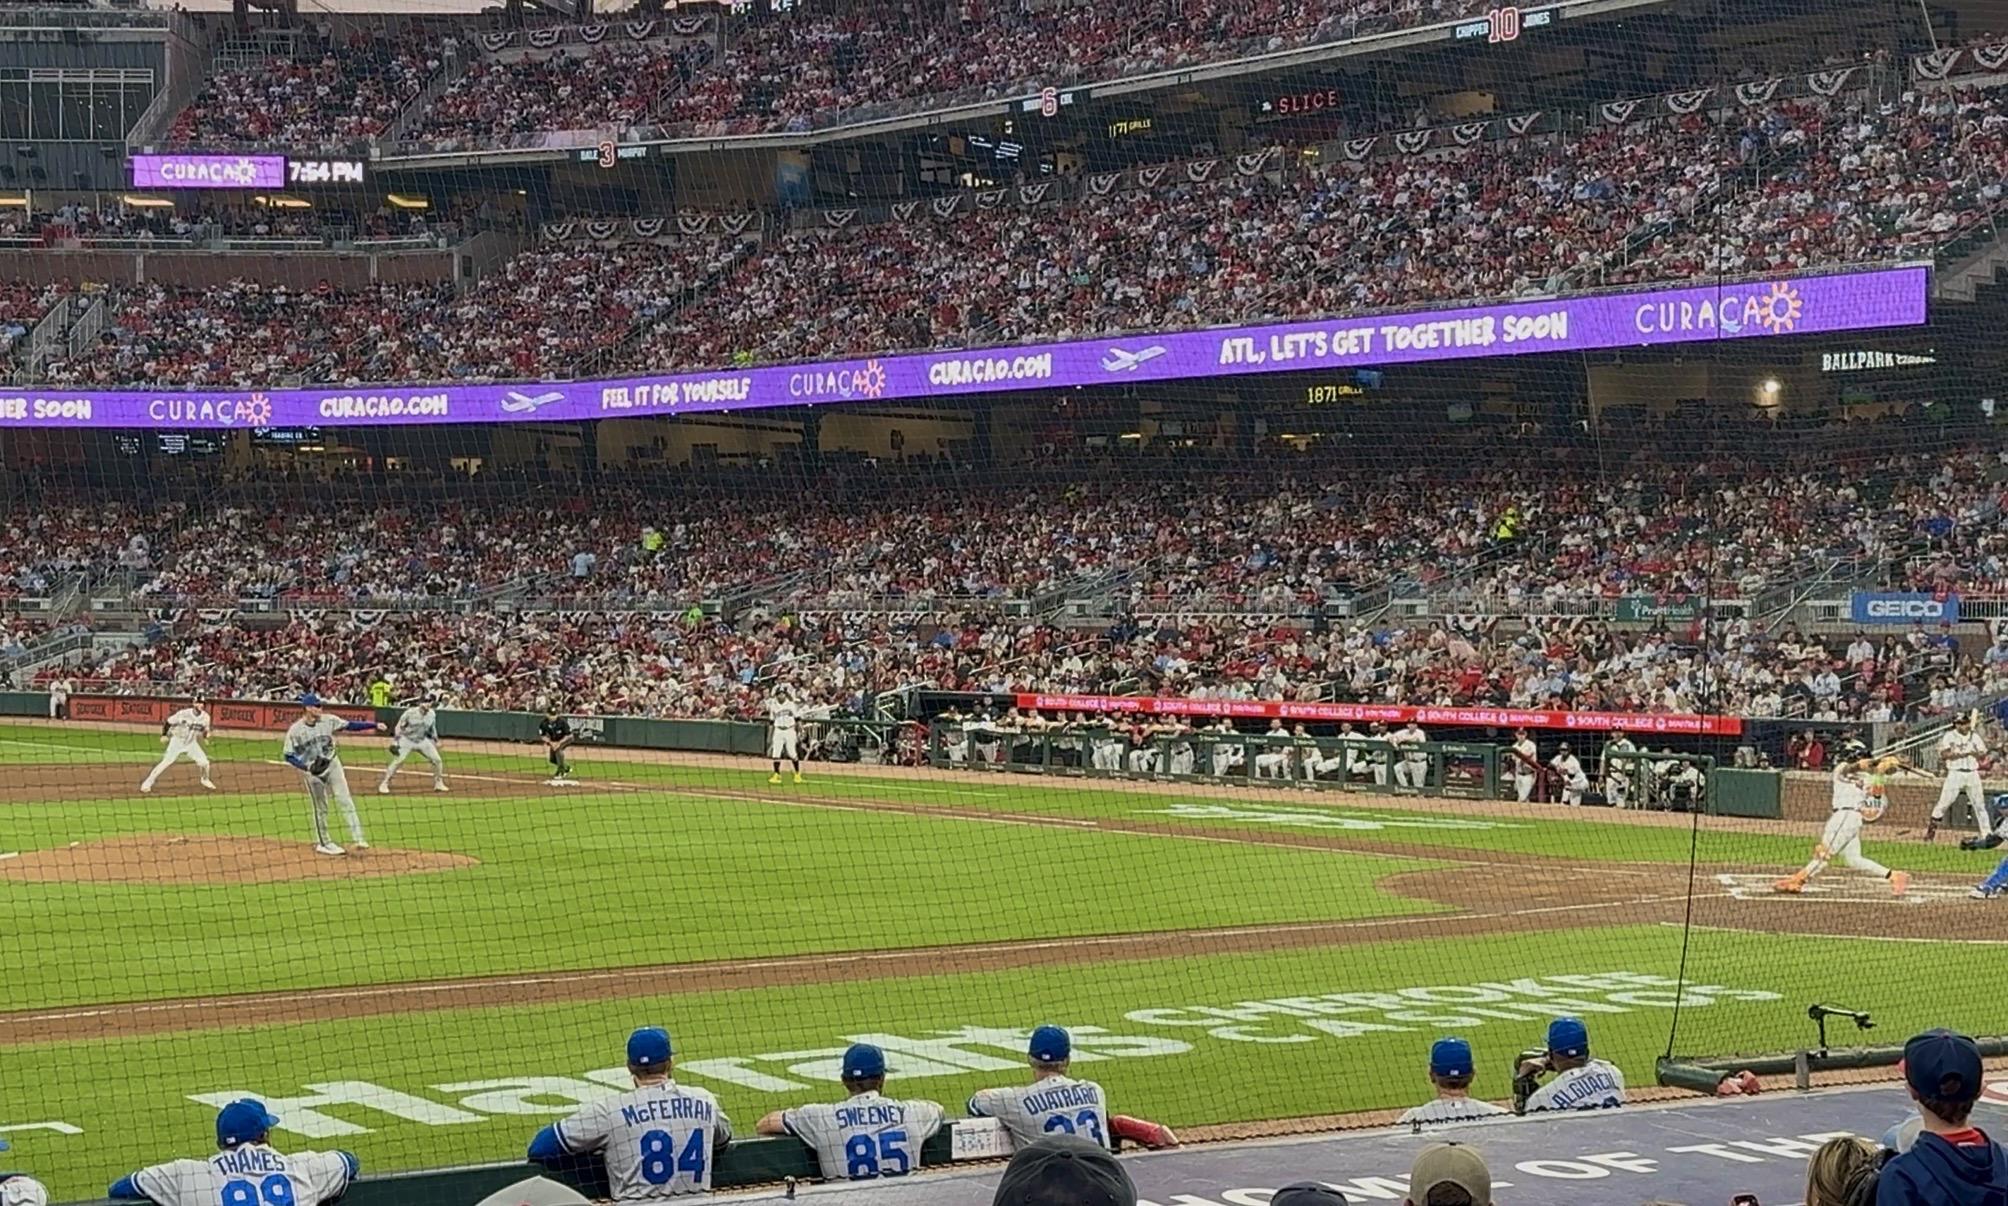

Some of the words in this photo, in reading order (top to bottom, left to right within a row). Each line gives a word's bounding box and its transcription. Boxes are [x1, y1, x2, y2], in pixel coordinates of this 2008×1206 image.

[1488, 7, 1519, 43] 10
[1042, 87, 1057, 117] 6
[1279, 91, 1336, 113] SLICE
[599, 140, 615, 168] 3
[288, 161, 330, 182] 7:54
[332, 161, 363, 182] PM
[1219, 338, 1266, 365] ATL,
[1270, 331, 1327, 361] LET'S
[1332, 328, 1375, 355] GET
[1381, 316, 1496, 351] TOGETHER
[1503, 311, 1568, 343] SOON
[1822, 351, 1894, 371] BALLPARK
[602, 387, 633, 410] FEEL
[635, 386, 650, 406] IT
[652, 382, 679, 406] FOR
[682, 377, 751, 404] YOURSELF
[1308, 386, 1337, 403] 1871
[34, 398, 92, 420] SOON
[1867, 600, 1944, 617] GEICO
[1427, 711, 1456, 720] SOUTH
[1459, 712, 1497, 722] COLLEGE
[1577, 716, 1609, 726] SOUTH
[1611, 717, 1653, 728] COLLEGE
[1123, 971, 1694, 1026] CHEROKEE
[1207, 985, 1784, 1043] CASINOS
[621, 1097, 713, 1127] McFERRAN
[836, 1105, 904, 1129] SWEENEY
[213, 1147, 285, 1176] THAMES
[640, 1128, 705, 1185] 84
[845, 1130, 909, 1180] 85
[1515, 1152, 1659, 1179] OF
